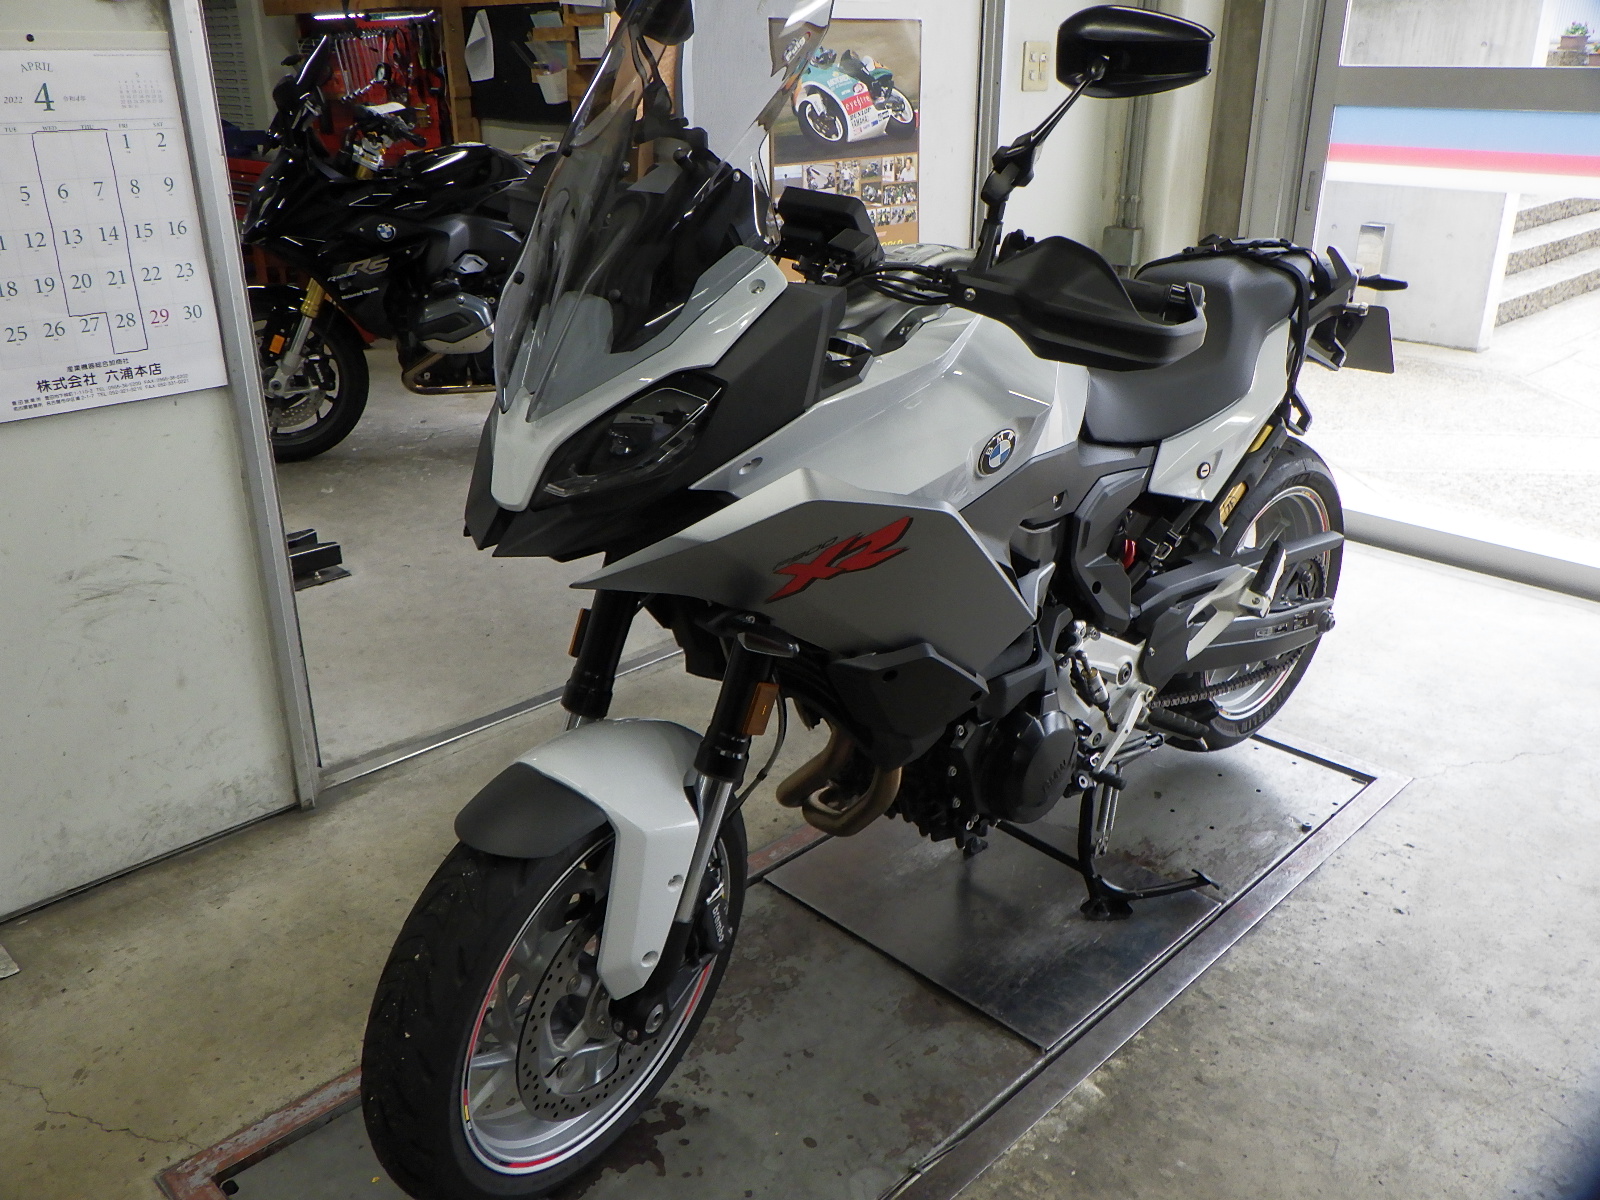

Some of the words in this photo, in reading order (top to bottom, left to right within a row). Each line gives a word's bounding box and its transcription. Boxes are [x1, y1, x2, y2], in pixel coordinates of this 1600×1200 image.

[786, 36, 806, 62] Puig
[20, 62, 53, 73] APRIL
[3, 96, 23, 104] 2022
[34, 82, 56, 112] 4
[122, 133, 130, 149] 1
[156, 132, 167, 148] 2
[20, 186, 31, 202] 5
[57, 183, 69, 199] 6
[93, 181, 104, 197] 7
[130, 179, 141, 195] 8
[163, 177, 174, 192] 9
[25, 232, 47, 248] 12
[62, 229, 83, 245] 13
[99, 226, 119, 242] 14
[134, 223, 154, 239] 15
[168, 220, 187, 236] 16
[0, 281, 18, 298] 18
[34, 277, 55, 294] 19
[70, 273, 92, 290] 20
[107, 270, 127, 286] 21
[141, 266, 162, 282] 22
[175, 262, 194, 279] 23
[347, 257, 390, 275] RS
[5, 326, 28, 343] 25
[43, 321, 66, 338] 26
[80, 316, 100, 333] 27
[115, 312, 136, 329] 28
[150, 308, 170, 325] 29
[183, 304, 202, 320] 30
[37, 372, 97, 393] 株式会社
[105, 363, 162, 383] 六浦本店
[765, 516, 914, 604] XR
[712, 903, 725, 942] brembo
